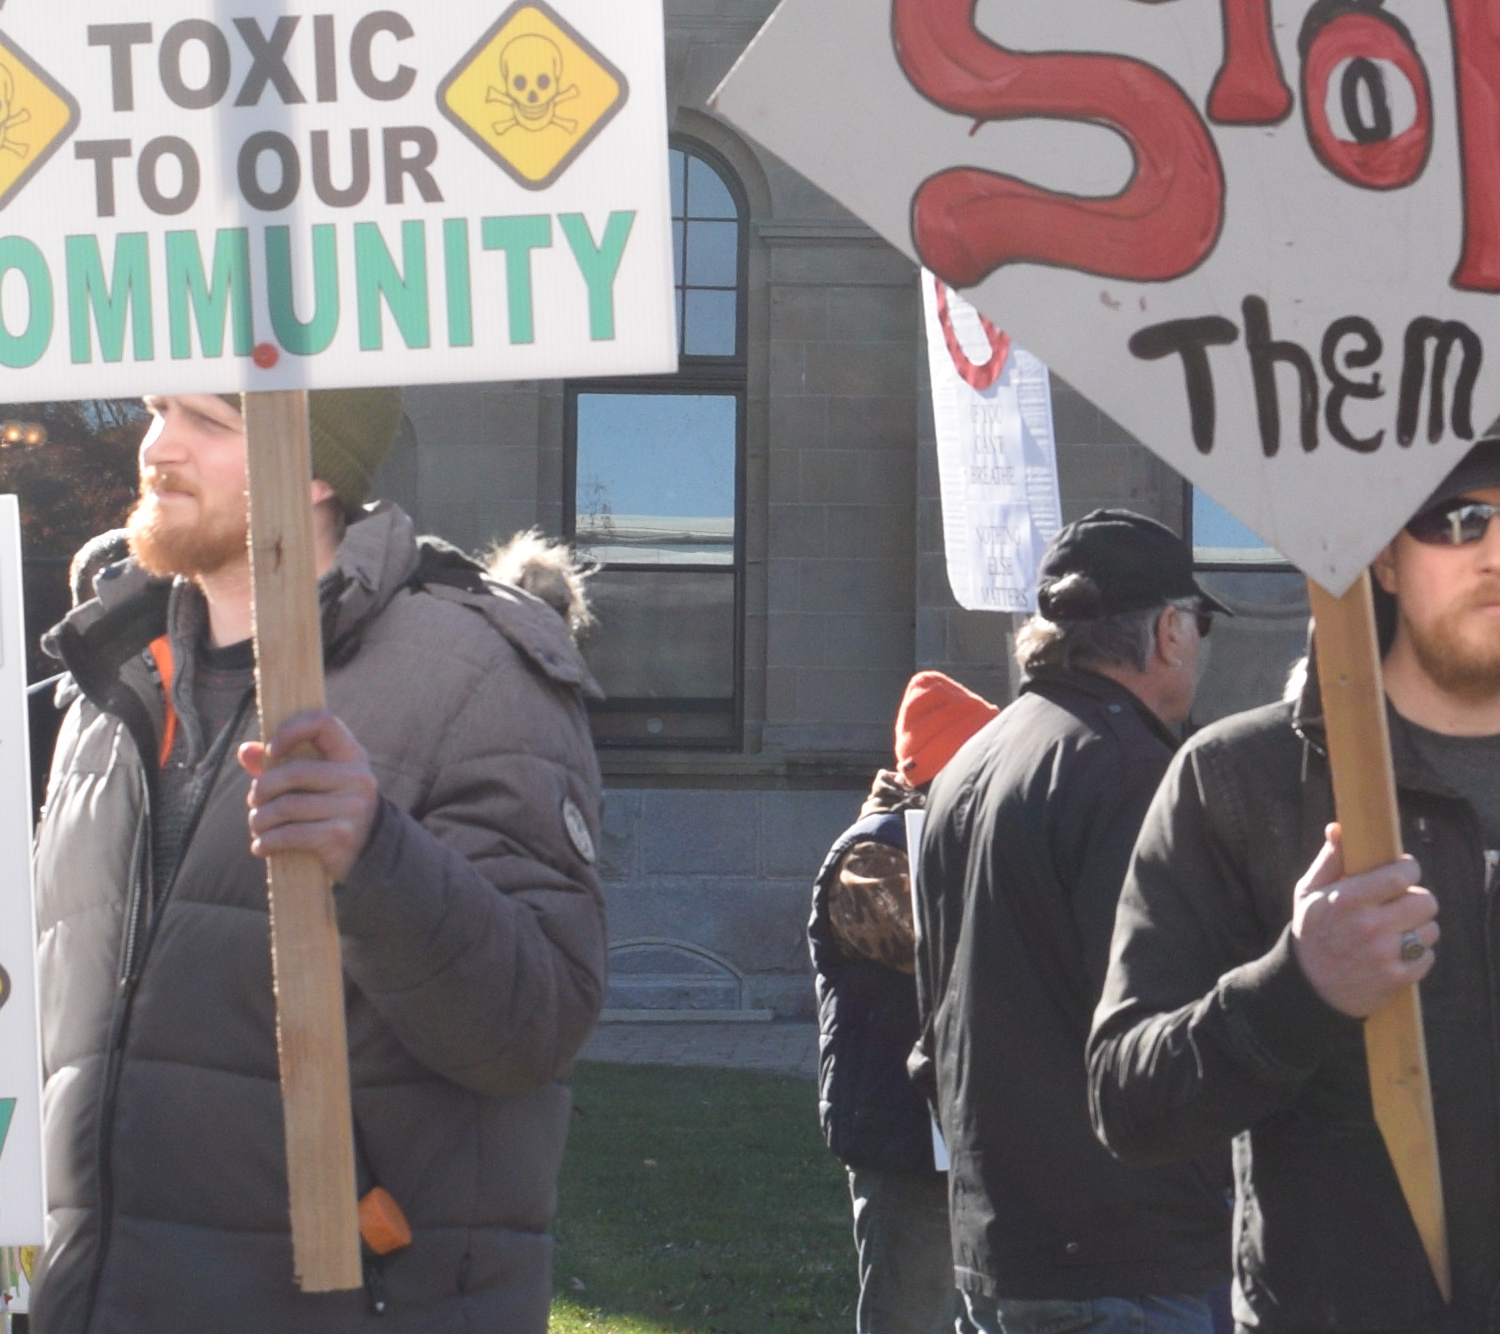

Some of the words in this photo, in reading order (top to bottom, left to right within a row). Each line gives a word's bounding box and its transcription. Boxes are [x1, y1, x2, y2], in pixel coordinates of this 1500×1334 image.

[86, 10, 418, 114] TOXIC
[75, 136, 201, 218] TO
[236, 126, 445, 213] OUR
[1128, 293, 1485, 459] Them
